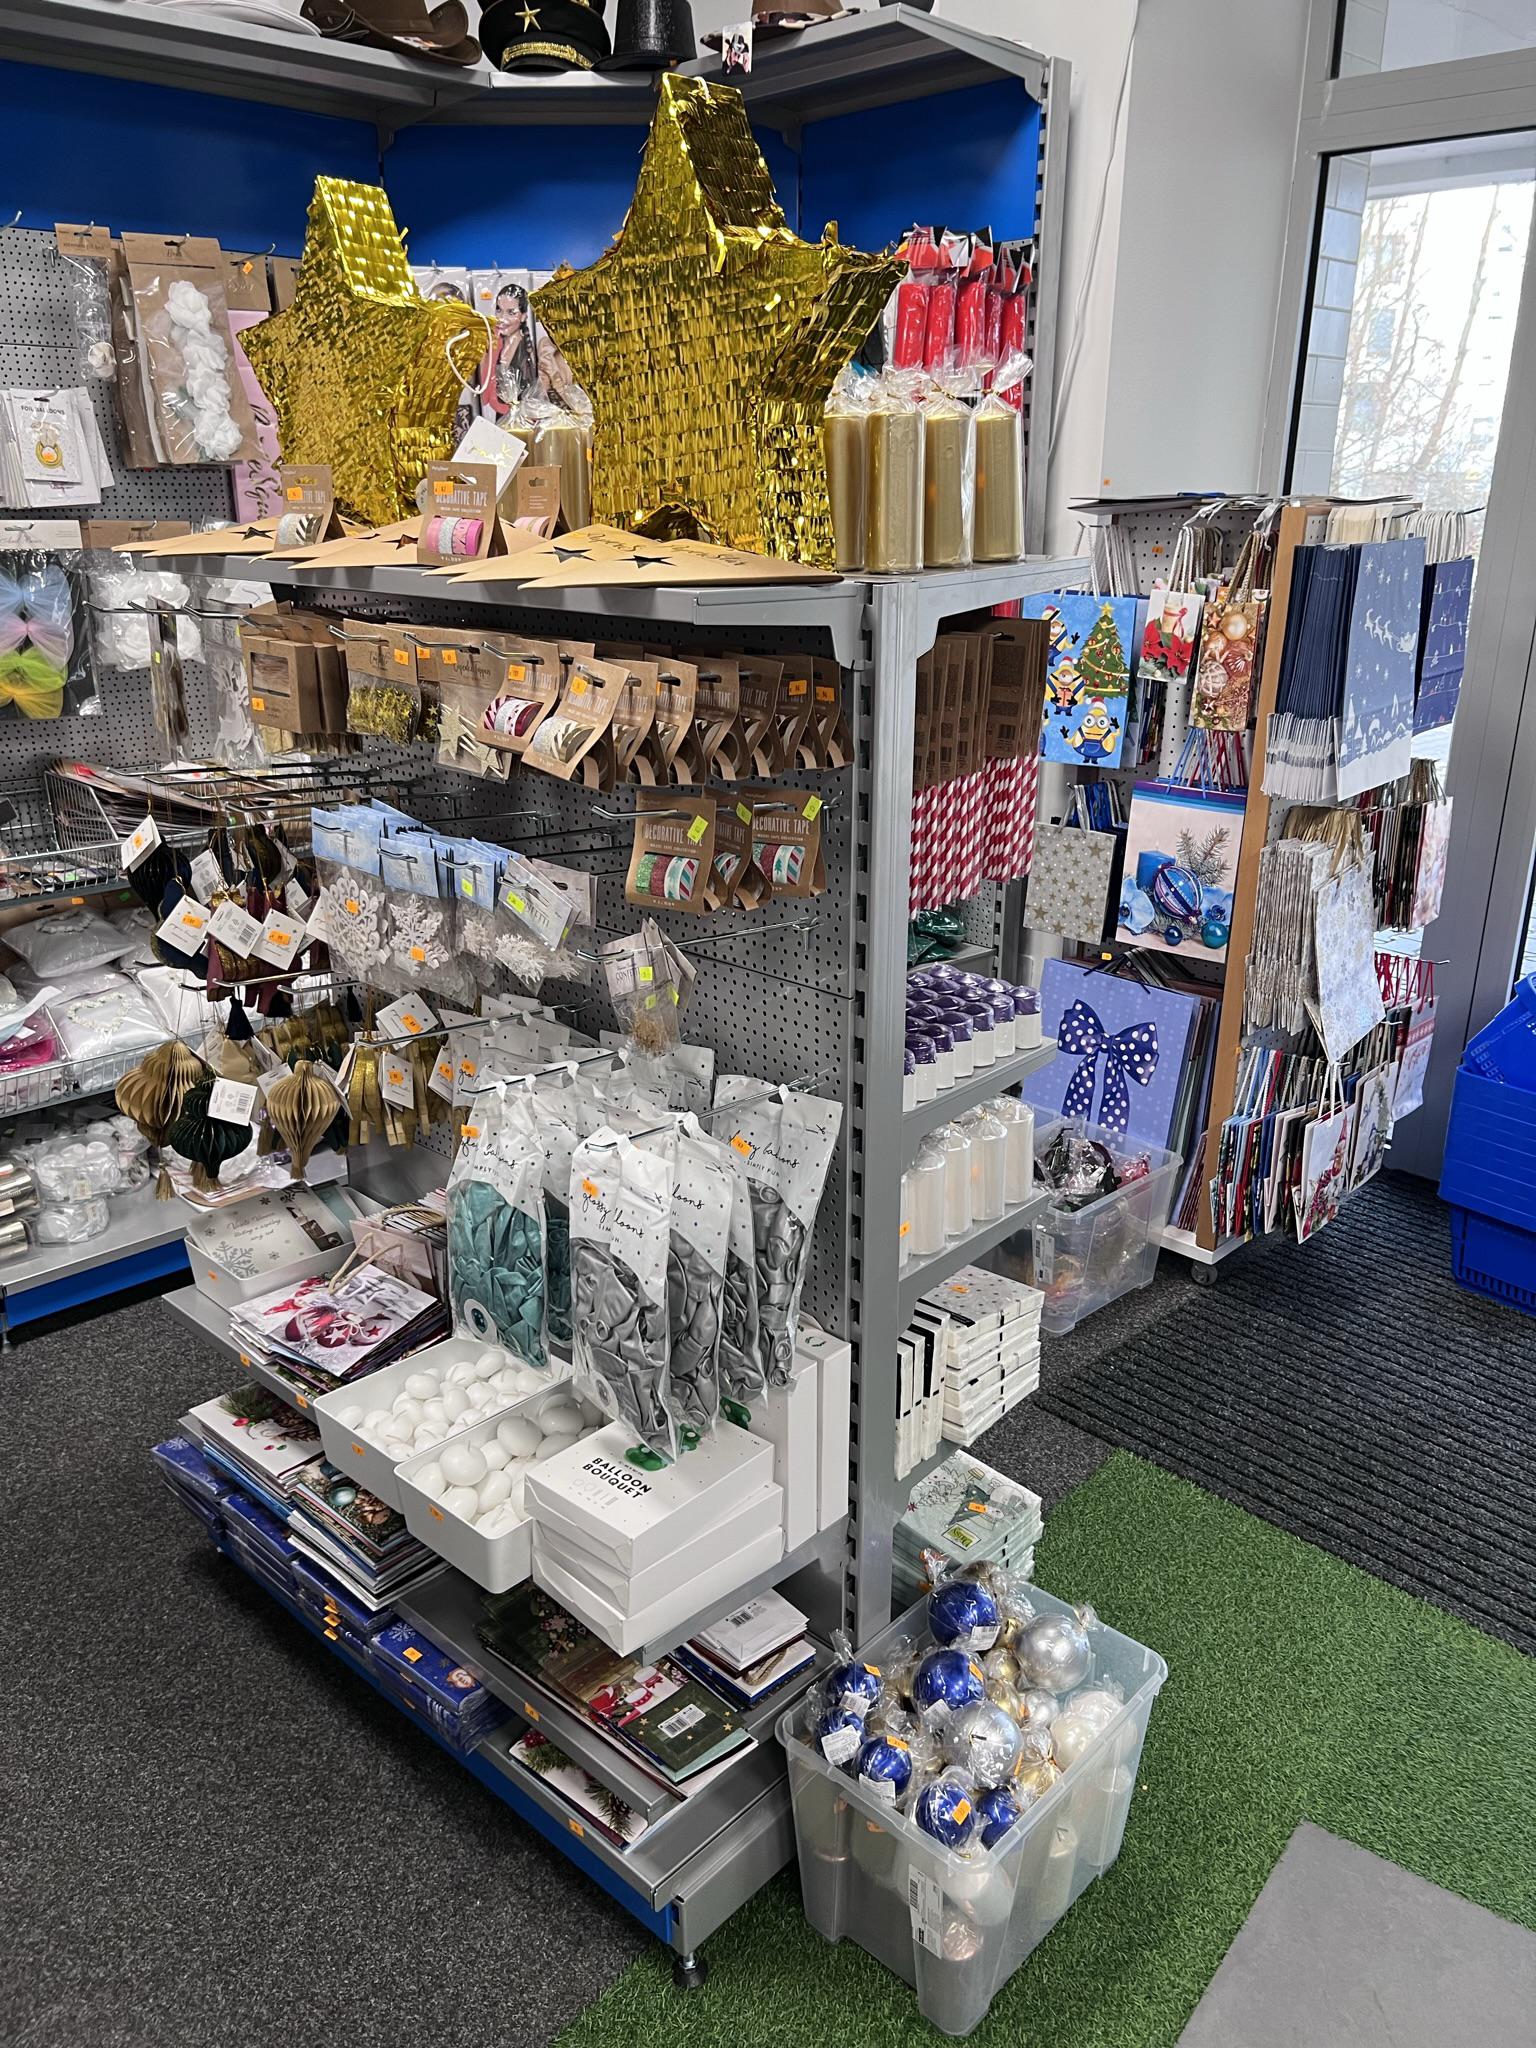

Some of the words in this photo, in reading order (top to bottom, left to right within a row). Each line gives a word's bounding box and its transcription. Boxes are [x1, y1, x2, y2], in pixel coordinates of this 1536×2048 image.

[473, 491, 488, 507] TAPE
[644, 822, 684, 845] DECORATIVE
[793, 818, 810, 835] TAPE
[582, 1463, 644, 1499] BOUQUET
[591, 1457, 652, 1494] BALLOON
